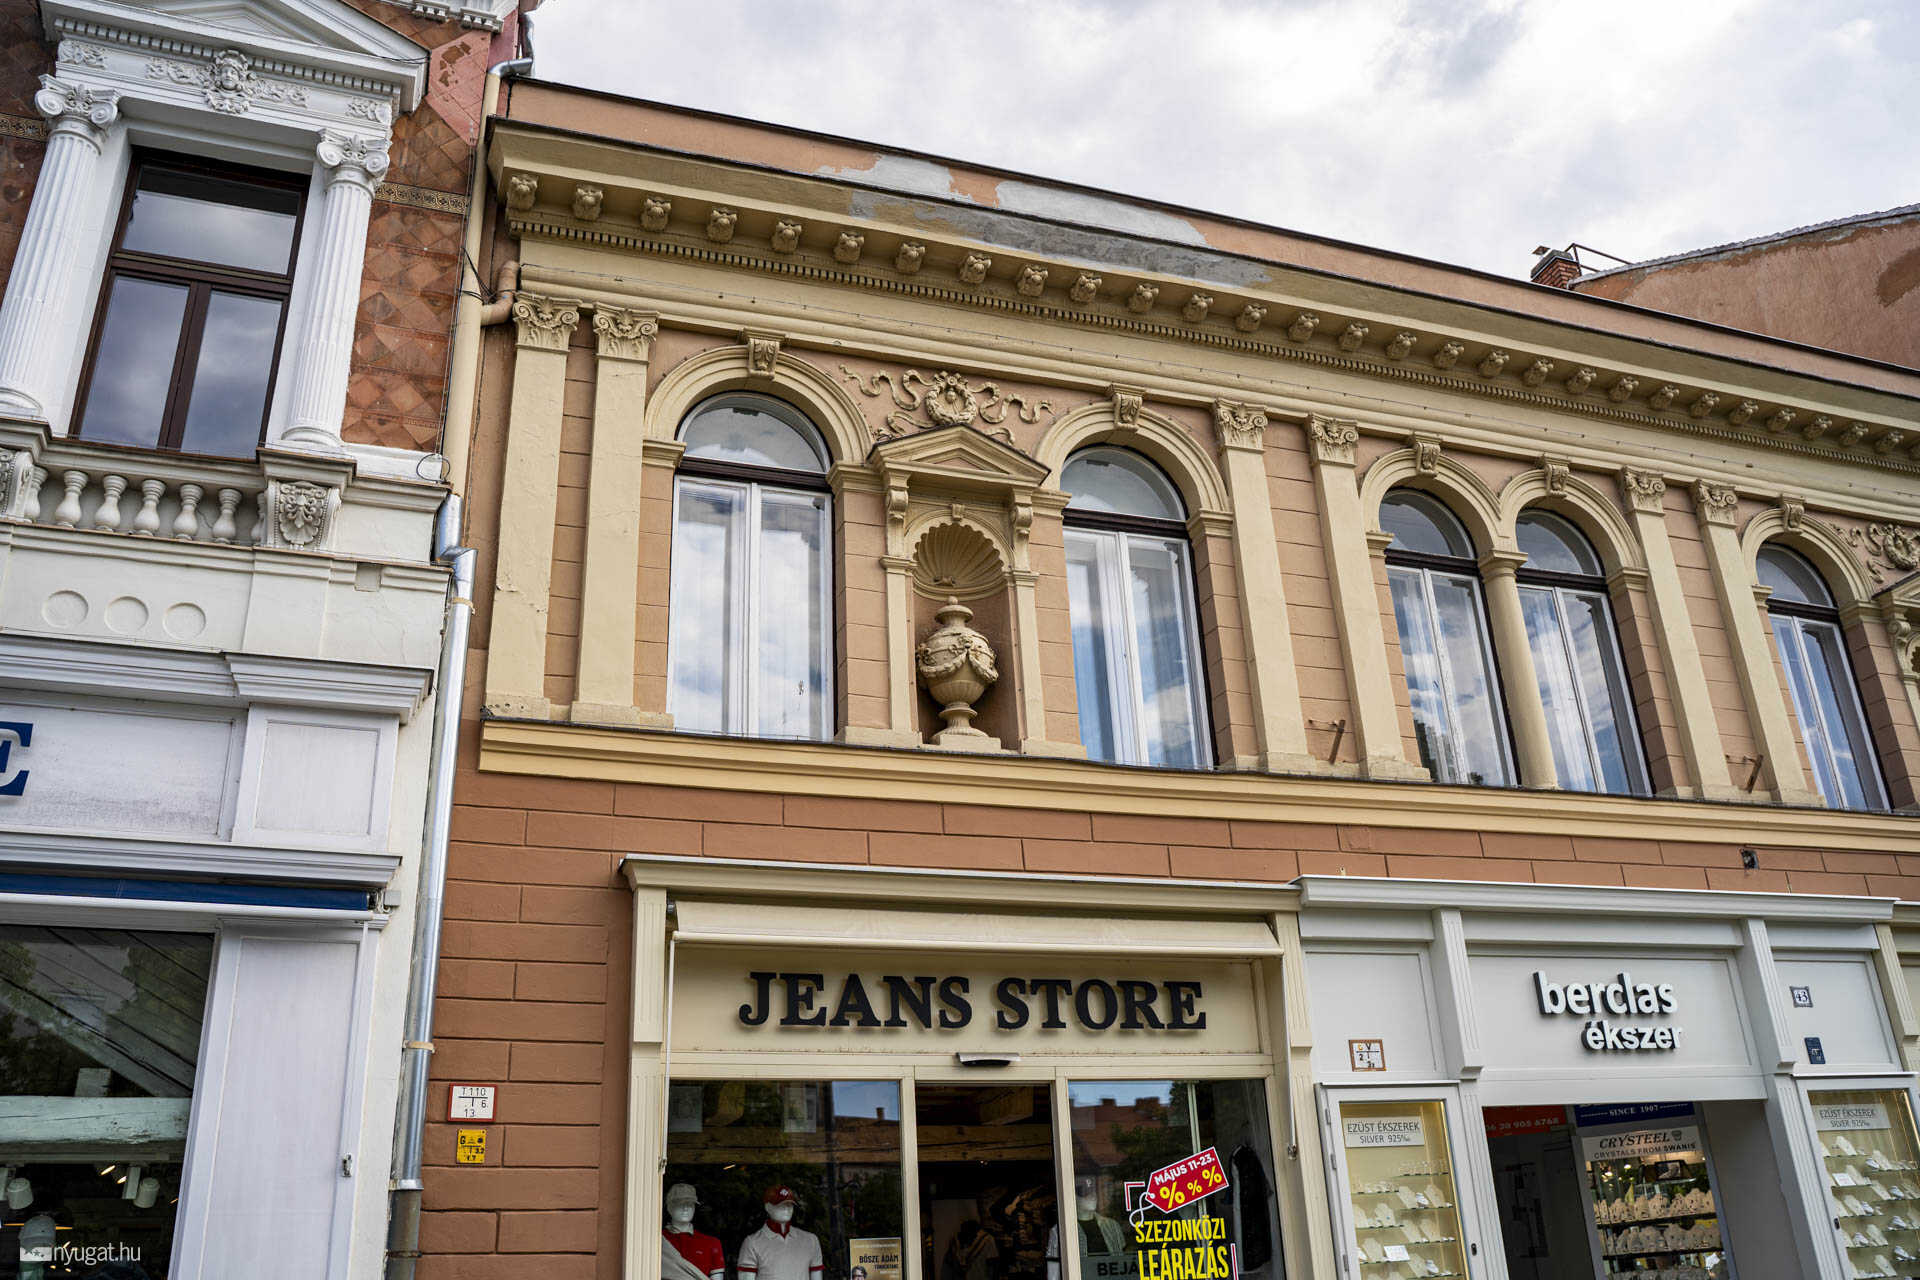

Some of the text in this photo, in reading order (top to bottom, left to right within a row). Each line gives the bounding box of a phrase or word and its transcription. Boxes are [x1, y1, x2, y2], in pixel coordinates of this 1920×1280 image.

[738, 971, 1207, 1031] JEANS STORE
[1581, 1019, 1683, 1050] ékszer
[1347, 1119, 1420, 1133] EZÜST ÉKSZEREK
[1360, 1134, 1385, 1144] SILVER
[1599, 1131, 1671, 1149] CRYSTEEL
[1593, 1149, 1636, 1159] CRYSTALS
[1154, 1165, 1188, 1185] MÁJUS
[1135, 1214, 1227, 1243] SZEZONKÖZI
[1097, 1256, 1147, 1276] BEJÁ
[1137, 1241, 1230, 1280] LEÁRAZÁS
